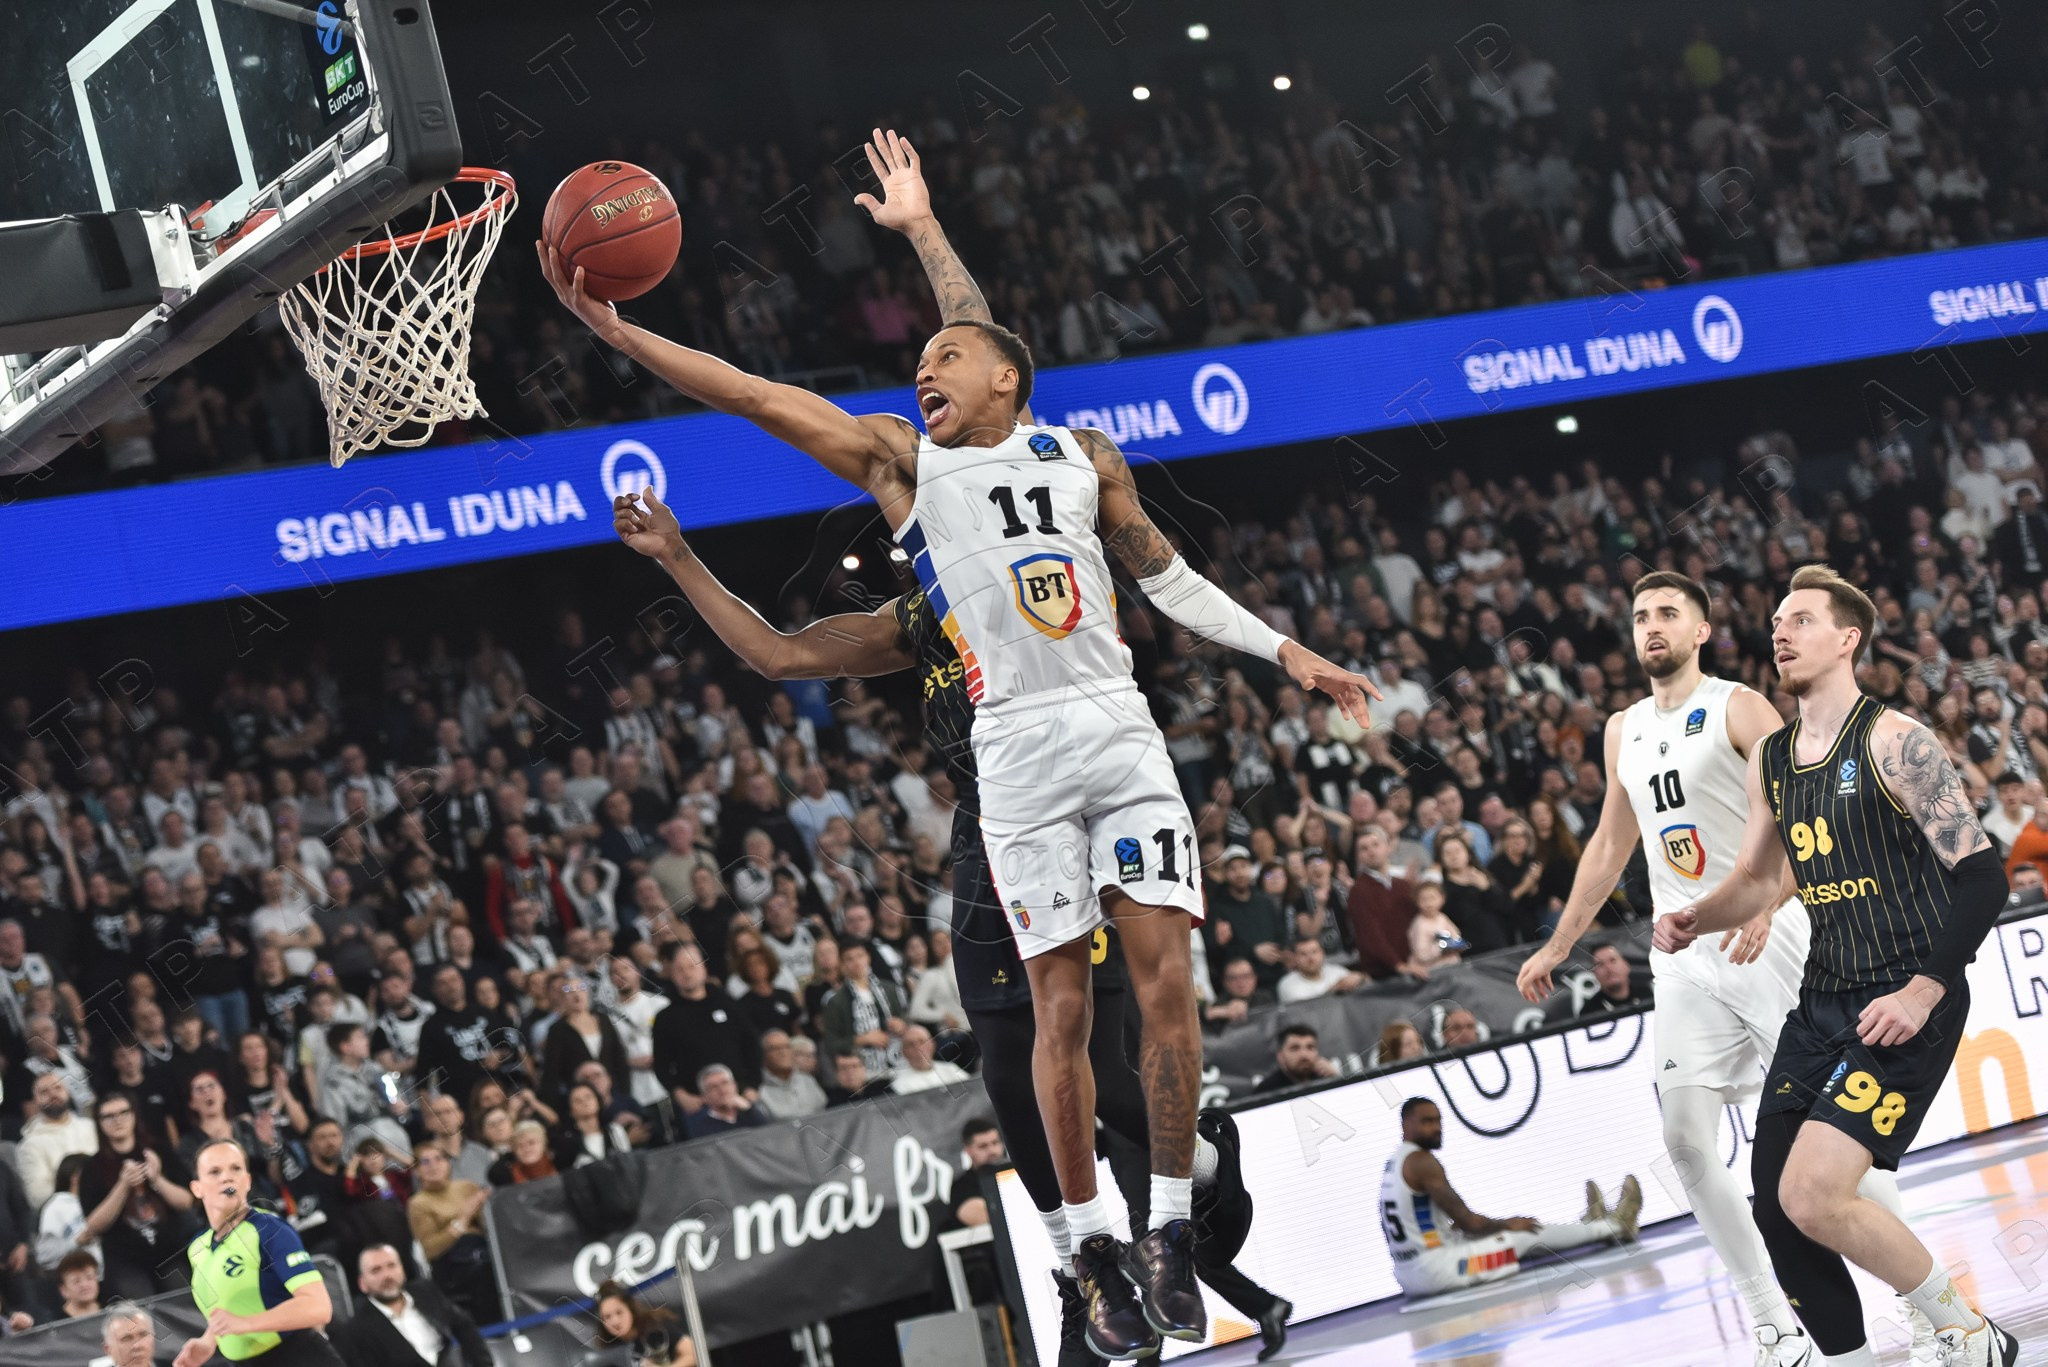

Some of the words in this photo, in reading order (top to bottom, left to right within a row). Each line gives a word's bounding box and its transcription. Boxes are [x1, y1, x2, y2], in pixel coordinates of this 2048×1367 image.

[325, 55, 354, 90] BKT
[327, 81, 365, 116] EuroCup
[1928, 280, 2037, 327] SIGNAL
[1463, 342, 1587, 394] SIGNAL
[1584, 328, 1687, 377] IDUNA
[275, 501, 447, 563] SIGNAL
[448, 480, 588, 539] IDUNA
[988, 486, 1063, 539] 11
[1025, 571, 1068, 604] BT
[1648, 768, 1686, 814] 10
[1152, 828, 1196, 892] 11
[1669, 837, 1693, 858] BT
[1790, 816, 1834, 862] 98
[1120, 873, 1143, 881] EuroCup
[1052, 898, 1072, 911] PEAK
[1834, 1070, 1907, 1137] 98
[572, 1217, 721, 1298] cea
[733, 1156, 885, 1261] mai
